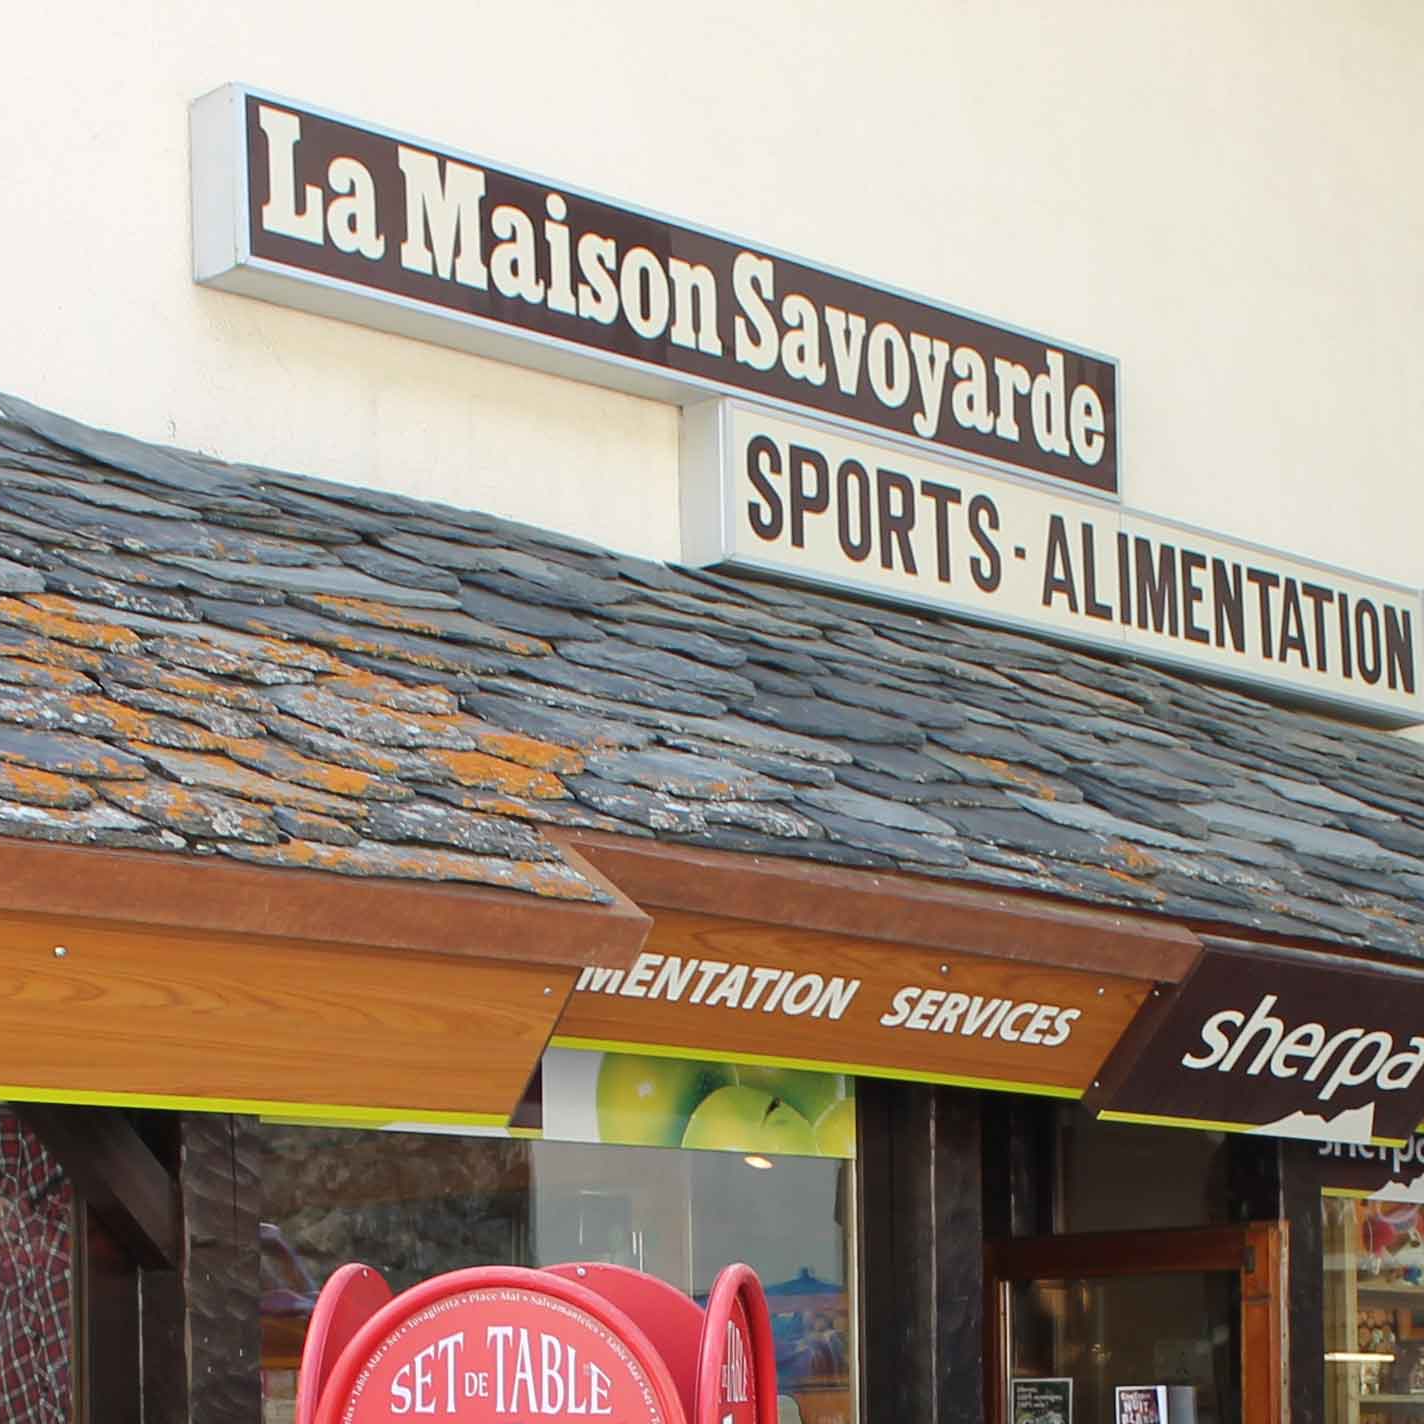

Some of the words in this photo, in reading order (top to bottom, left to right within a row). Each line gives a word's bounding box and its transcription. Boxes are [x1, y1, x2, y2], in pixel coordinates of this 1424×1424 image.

[258, 105, 384, 262] La
[398, 145, 722, 358] Maison
[731, 250, 1107, 465] Savoyarde
[880, 986, 1081, 1047] SERVICES
[389, 1331, 465, 1415] SET
[464, 1370, 489, 1398] DE
[487, 1325, 614, 1416] TABLE
